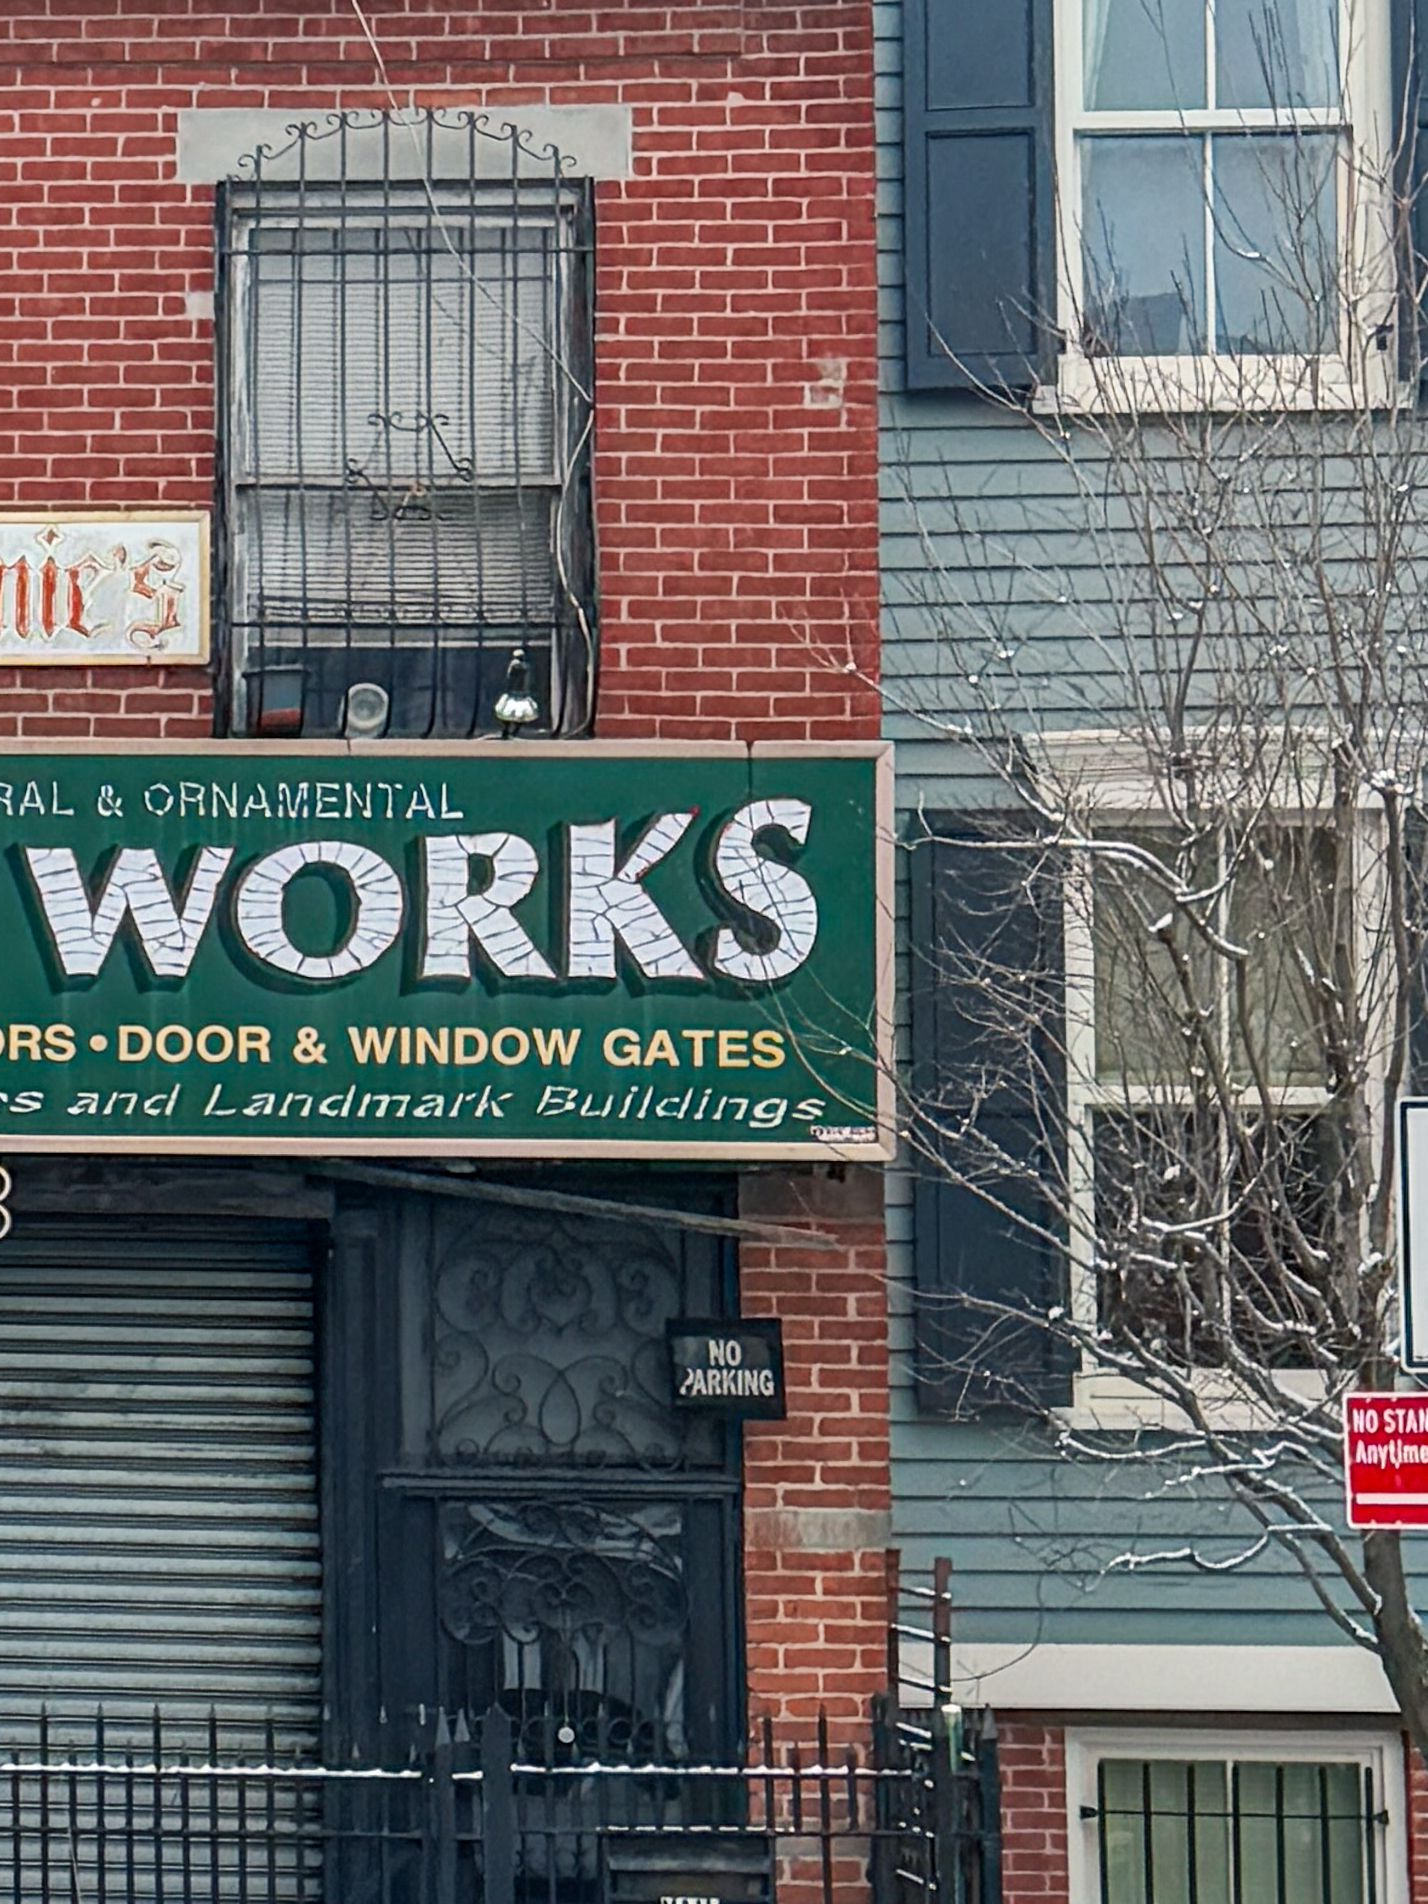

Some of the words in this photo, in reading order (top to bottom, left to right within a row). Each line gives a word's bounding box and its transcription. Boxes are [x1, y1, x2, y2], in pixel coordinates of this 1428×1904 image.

[97, 780, 123, 818] &
[145, 782, 466, 820] ORNAMENTAL
[23, 796, 819, 981] WORKS
[118, 1023, 276, 1065] DOOR
[292, 1024, 327, 1066] &
[348, 1024, 584, 1067] WINDOW
[602, 1026, 786, 1070] GATES
[67, 1081, 180, 1119] and
[203, 1081, 509, 1121] Landmark
[538, 1086, 826, 1128] Buildings
[708, 1339, 742, 1366] NO
[1352, 1408, 1379, 1433] NO
